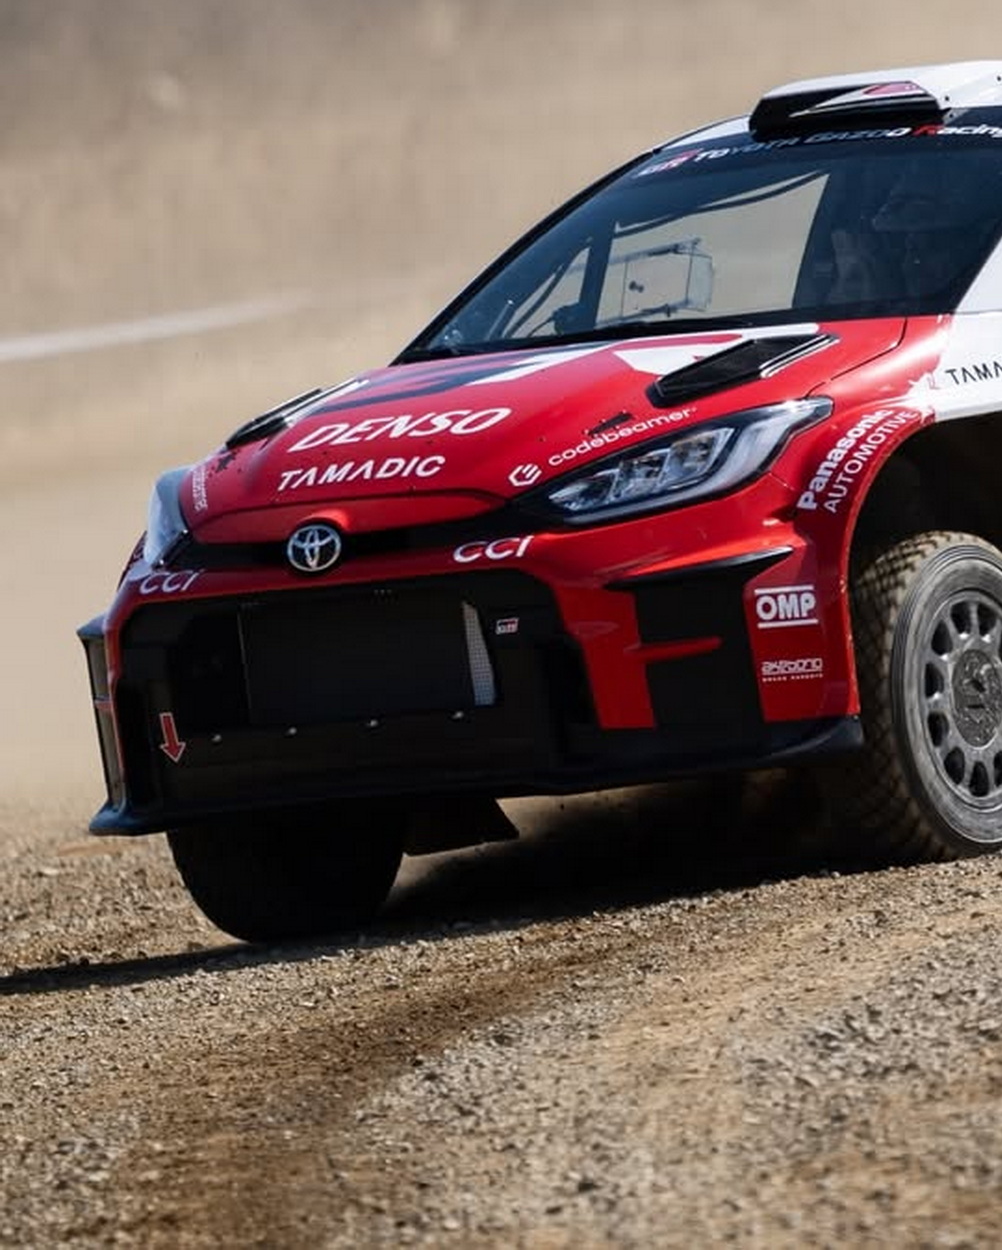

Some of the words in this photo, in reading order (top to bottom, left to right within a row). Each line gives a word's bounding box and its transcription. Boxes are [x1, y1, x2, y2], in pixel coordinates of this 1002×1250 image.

[287, 408, 512, 453] DENSO
[277, 455, 446, 491] TAMADIC
[796, 409, 894, 510] Panasonic
[824, 411, 919, 513] AUTOMOTIVE
[756, 592, 816, 621] OMP
